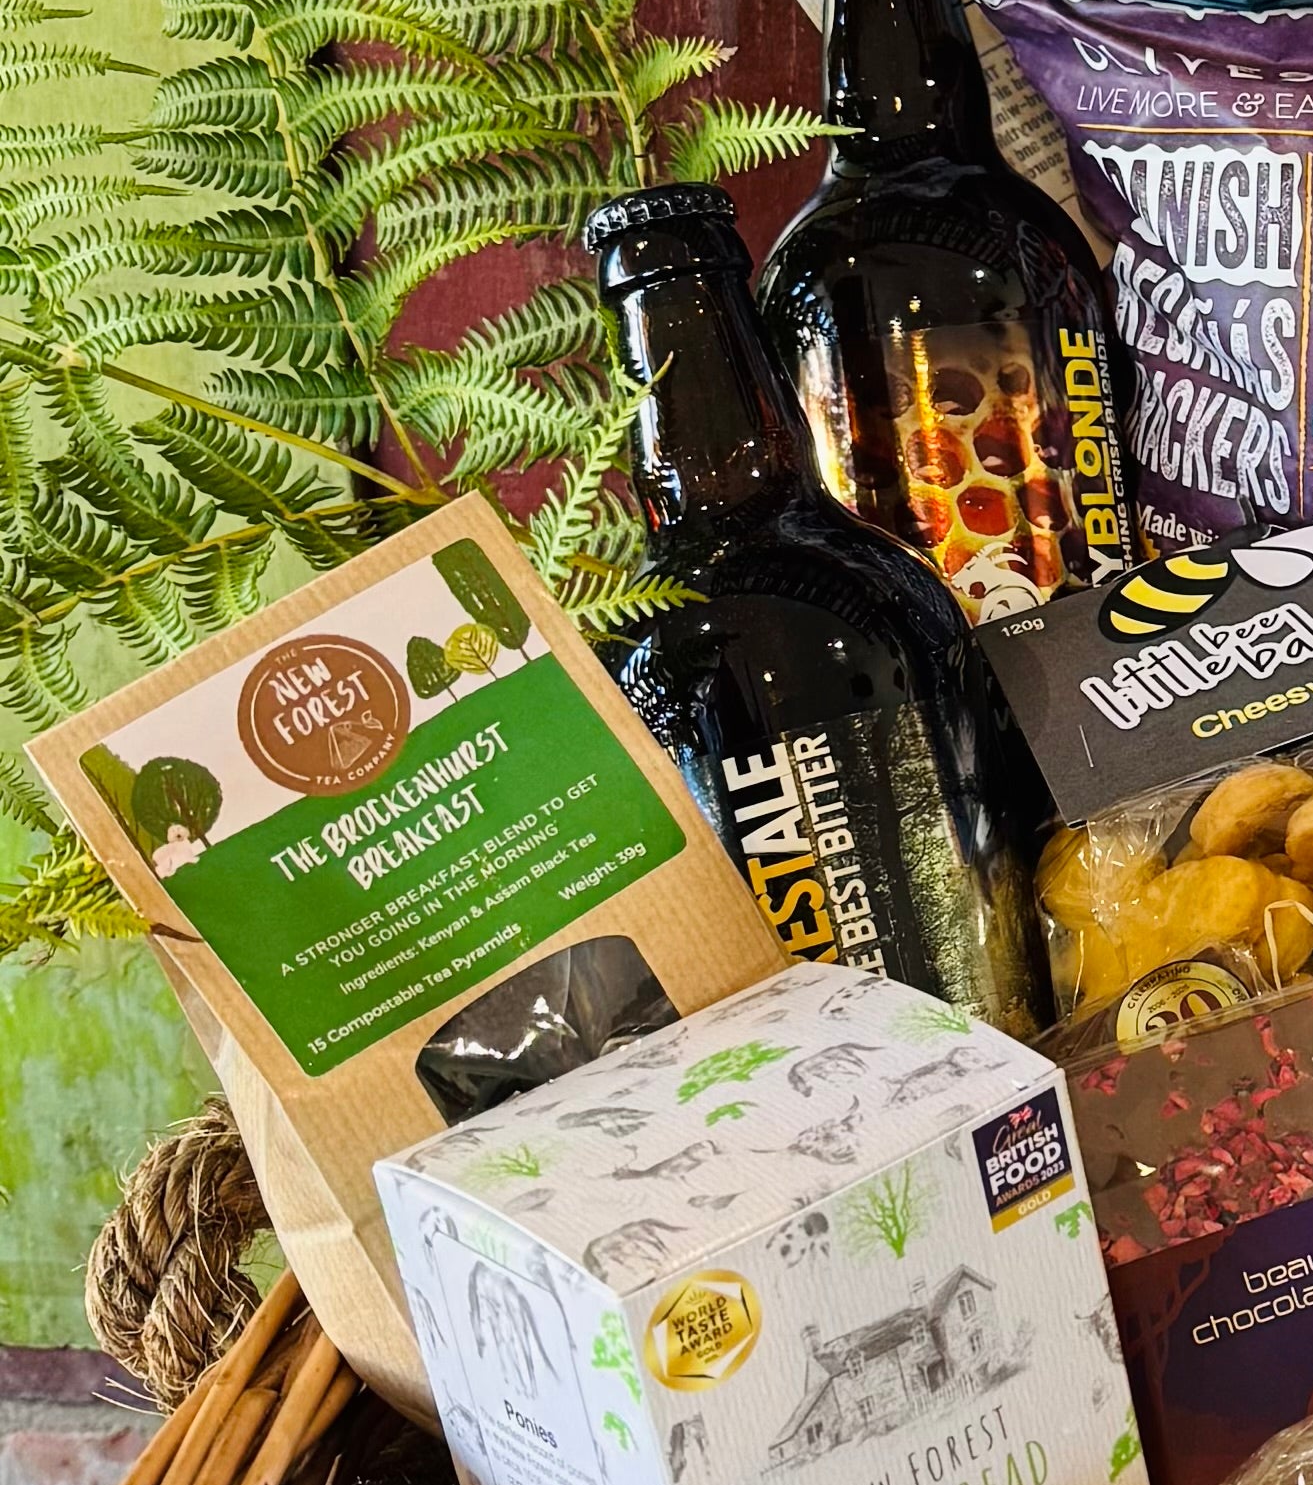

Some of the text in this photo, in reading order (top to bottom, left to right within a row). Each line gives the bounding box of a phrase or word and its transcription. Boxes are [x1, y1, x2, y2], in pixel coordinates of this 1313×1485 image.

[1001, 616, 1045, 637] 120g
[270, 658, 332, 704] NEW
[273, 670, 371, 745] FOREST
[270, 722, 510, 883] THE BROCKENHURST
[347, 784, 485, 892] BREAKFAST
[793, 732, 879, 949] BEST BITTER
[297, 820, 539, 968] STRONGER BLEND
[558, 860, 620, 904] Weight:
[990, 1142, 1063, 1193] FOOD
